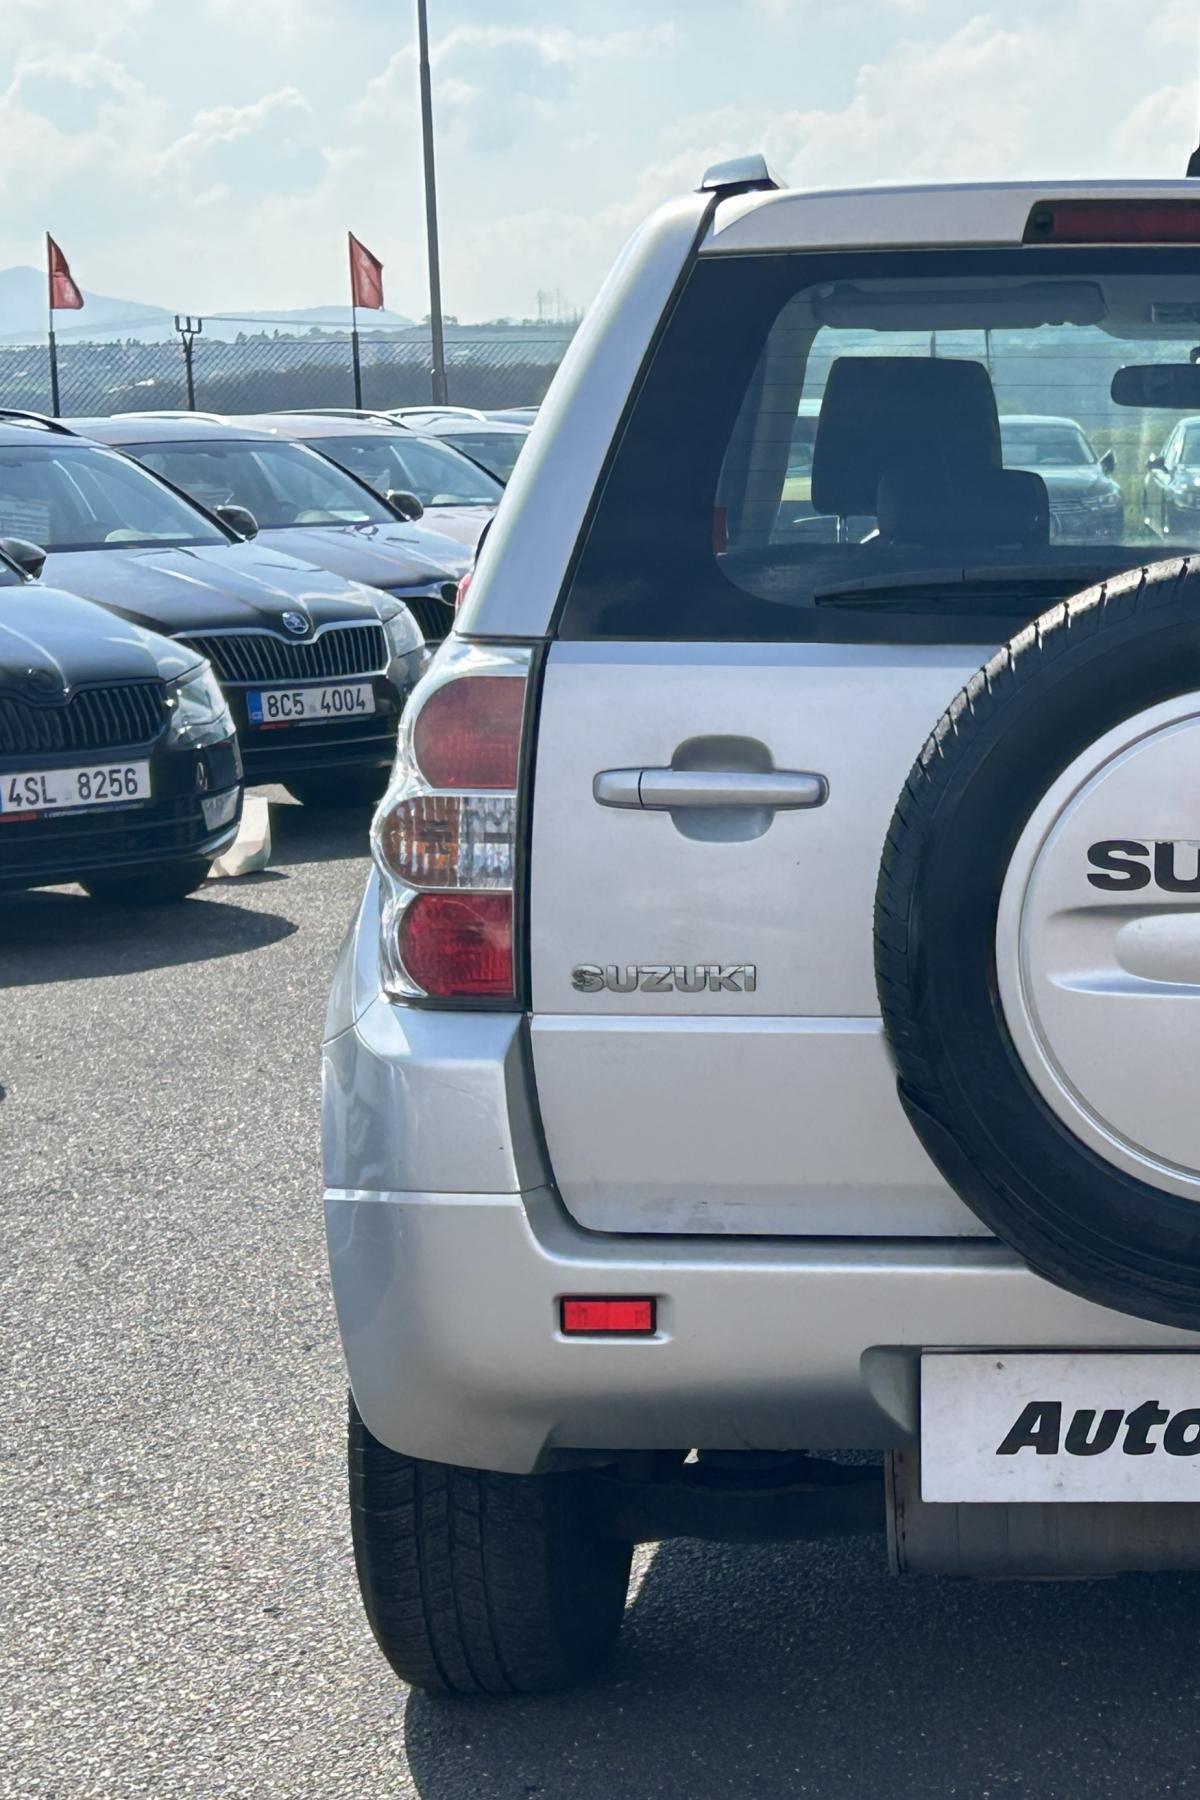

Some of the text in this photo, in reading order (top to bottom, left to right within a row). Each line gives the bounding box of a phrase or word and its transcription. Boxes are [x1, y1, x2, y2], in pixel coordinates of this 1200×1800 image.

[267, 688, 366, 717] 8C5 4004
[8, 768, 138, 807] 4SL 8256
[571, 963, 757, 994] SUZUKI
